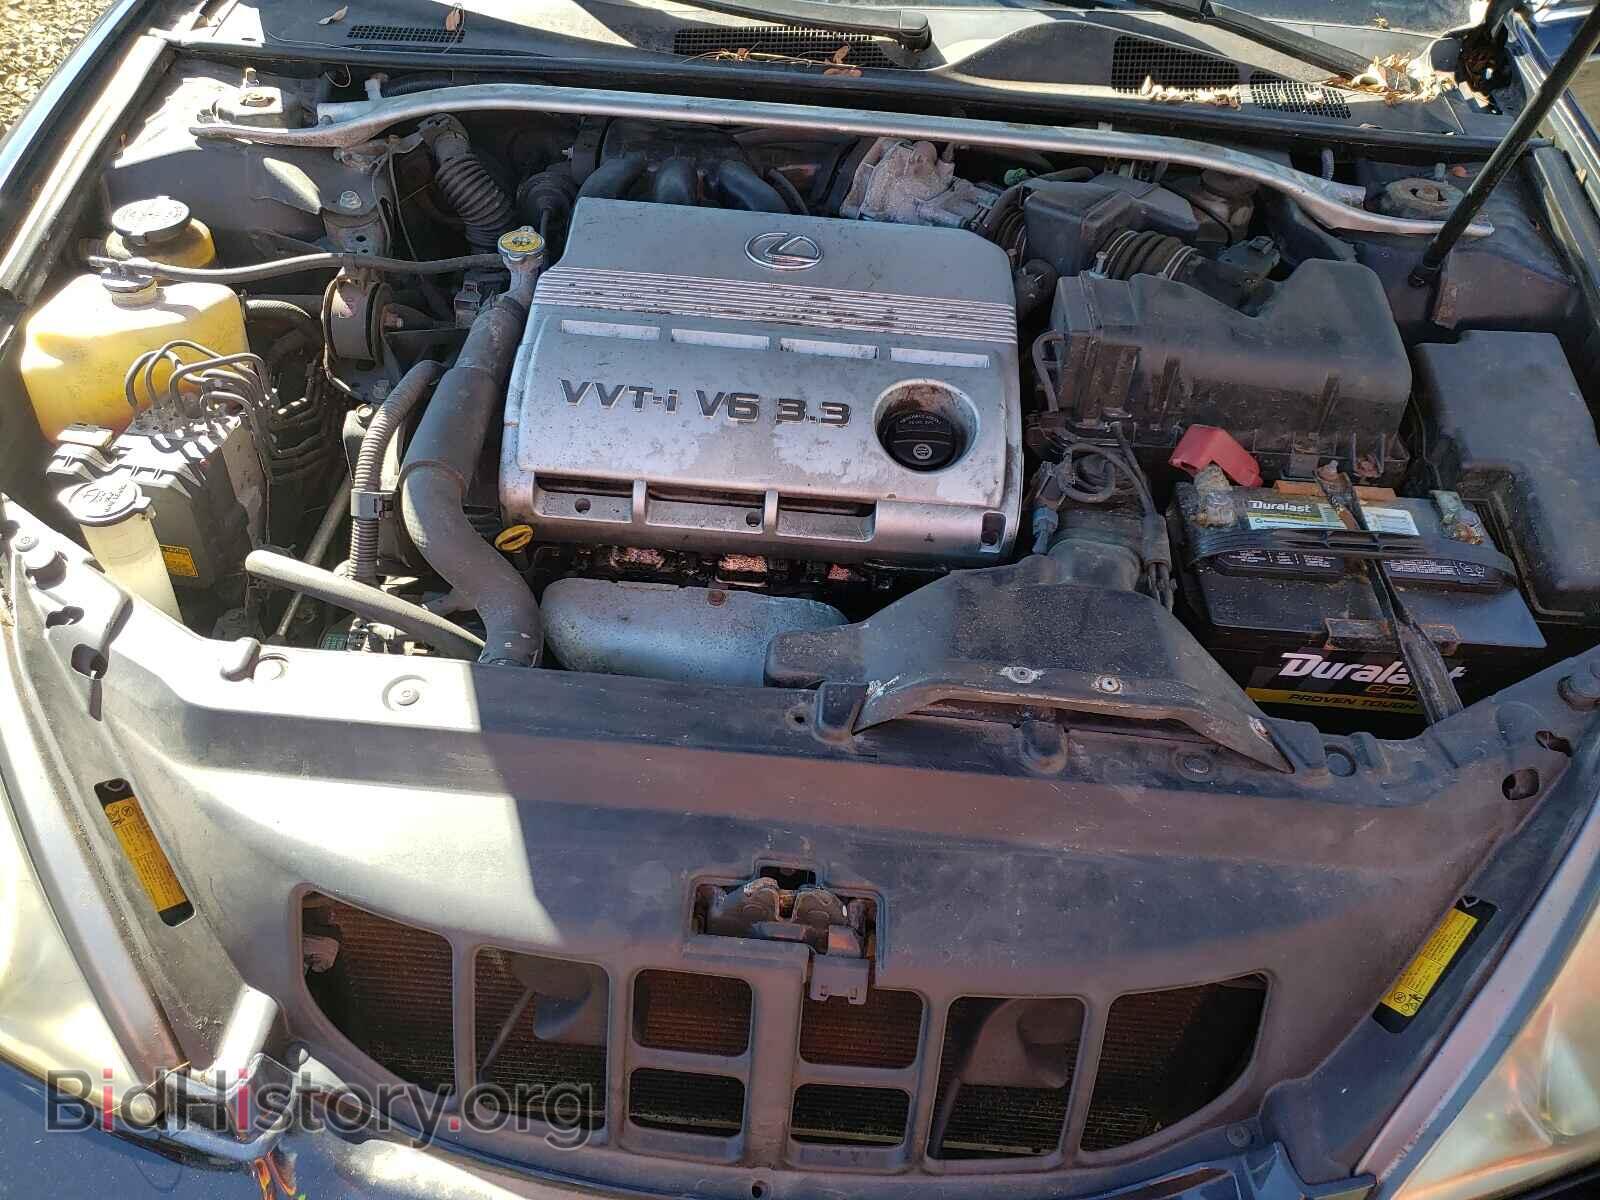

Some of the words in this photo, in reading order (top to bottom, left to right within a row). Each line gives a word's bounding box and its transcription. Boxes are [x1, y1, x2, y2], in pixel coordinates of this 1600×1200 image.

[560, 379, 678, 415] VVT-i
[695, 389, 760, 424] V6
[775, 397, 851, 427] 3.3
[1249, 500, 1313, 513] Duralast
[1288, 693, 1358, 706] PROVEN
